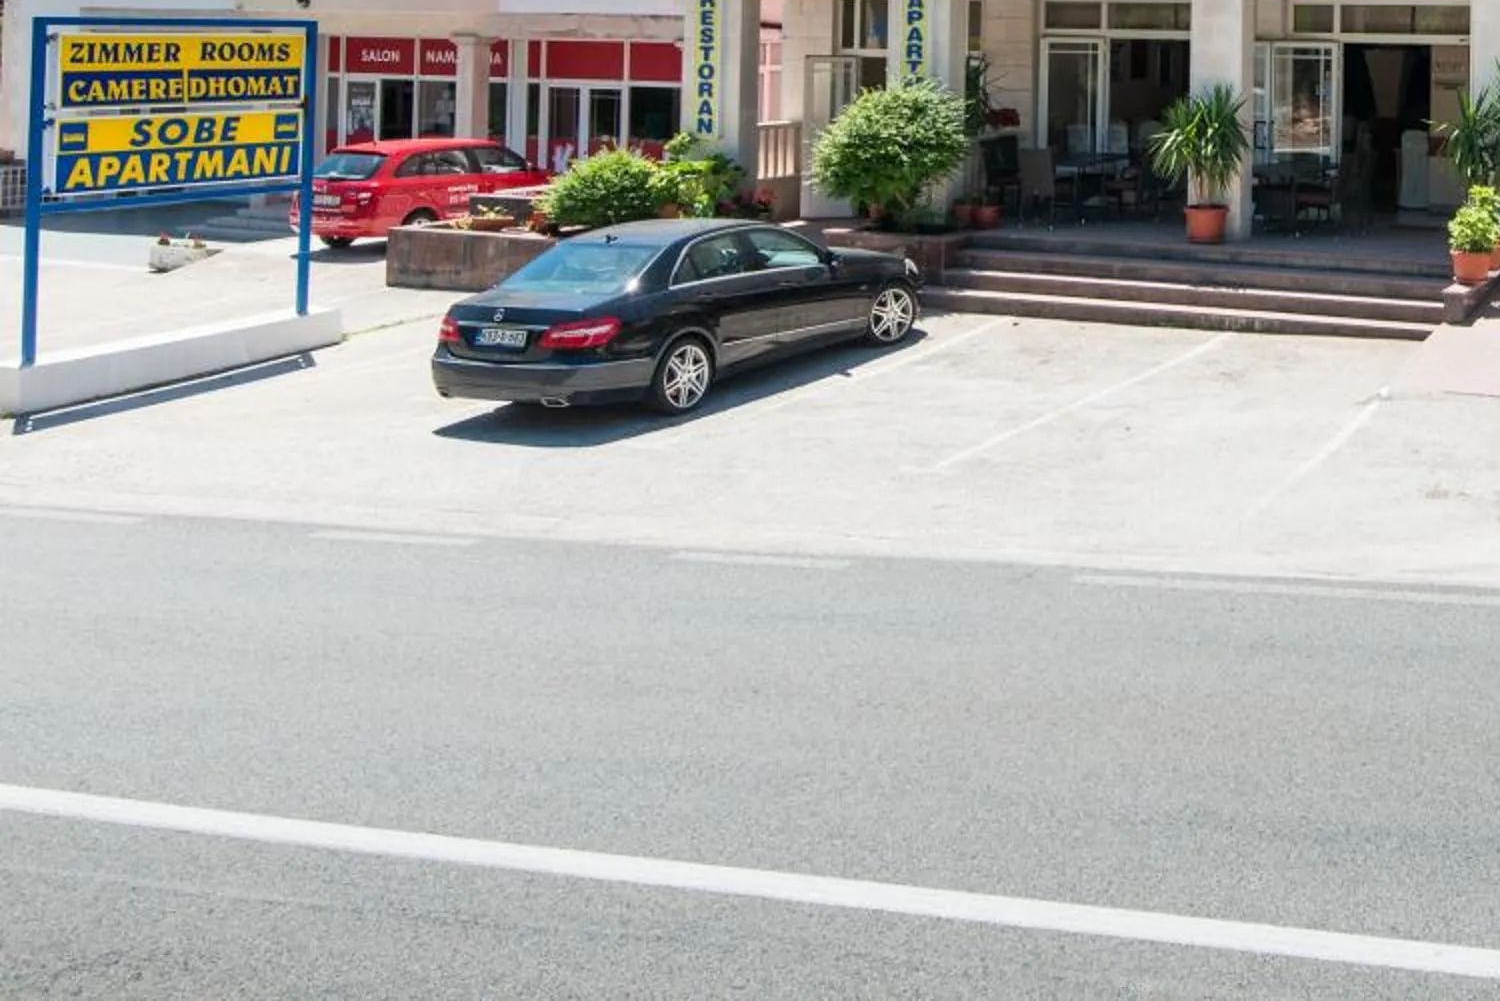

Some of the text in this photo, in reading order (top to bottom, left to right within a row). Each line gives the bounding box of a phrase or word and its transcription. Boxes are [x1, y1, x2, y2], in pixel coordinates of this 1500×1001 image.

[69, 41, 290, 63] ZIMMER ROOMS
[361, 50, 400, 62] SALON
[68, 75, 298, 103] CAMERE DHOMAT
[130, 116, 241, 147] SOBE
[65, 146, 291, 189] APARTMANI
